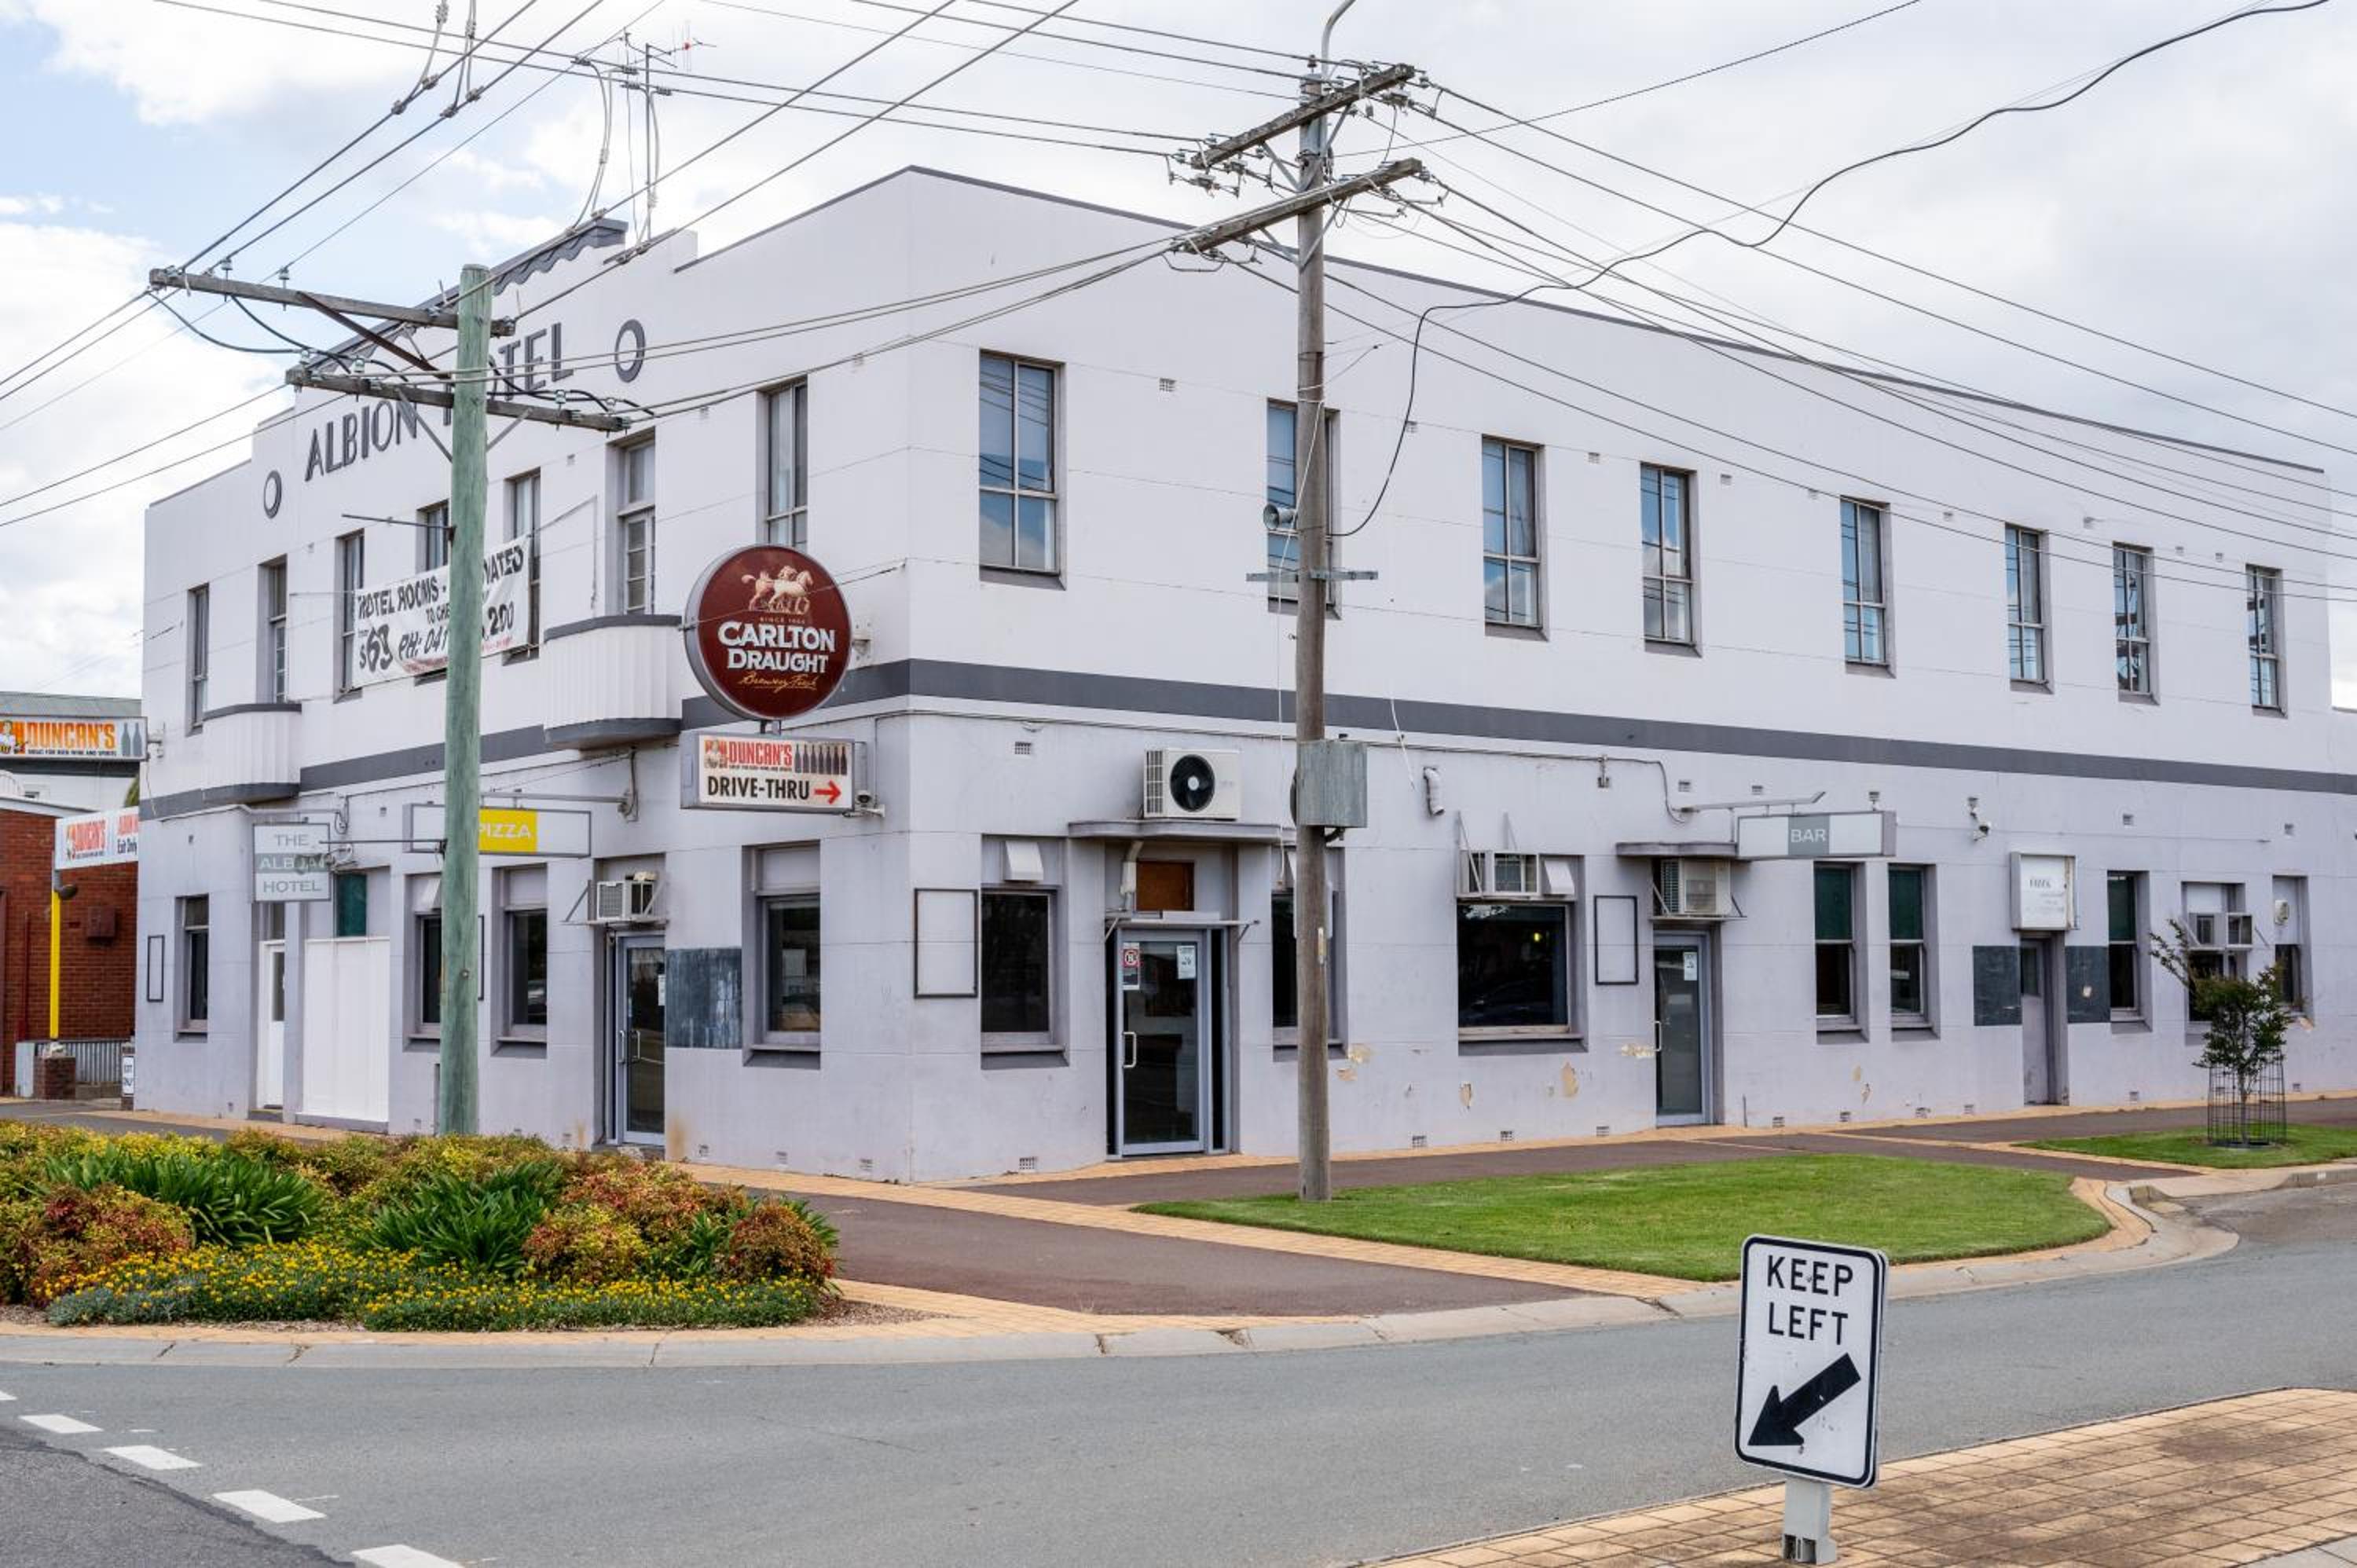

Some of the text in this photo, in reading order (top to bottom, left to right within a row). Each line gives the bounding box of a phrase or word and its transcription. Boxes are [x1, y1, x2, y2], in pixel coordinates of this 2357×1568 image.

[305, 387, 417, 482] ALBION
[358, 589, 395, 619] HOTEL
[398, 575, 439, 611] ROOMS
[484, 545, 524, 584] VATED
[398, 631, 422, 661] PH:
[717, 621, 836, 653] CARLTON
[728, 647, 830, 674] DRAUGHT
[27, 721, 116, 749] DUNCAN'S
[728, 741, 793, 767] DUNCAN'S
[707, 775, 810, 800] DRIVE-THRU
[275, 833, 309, 847] THE
[1791, 829, 1827, 843] BAR
[263, 879, 323, 892] HOTEL
[1767, 1255, 1853, 1297] KEEP
[1768, 1302, 1849, 1346] LEFT
